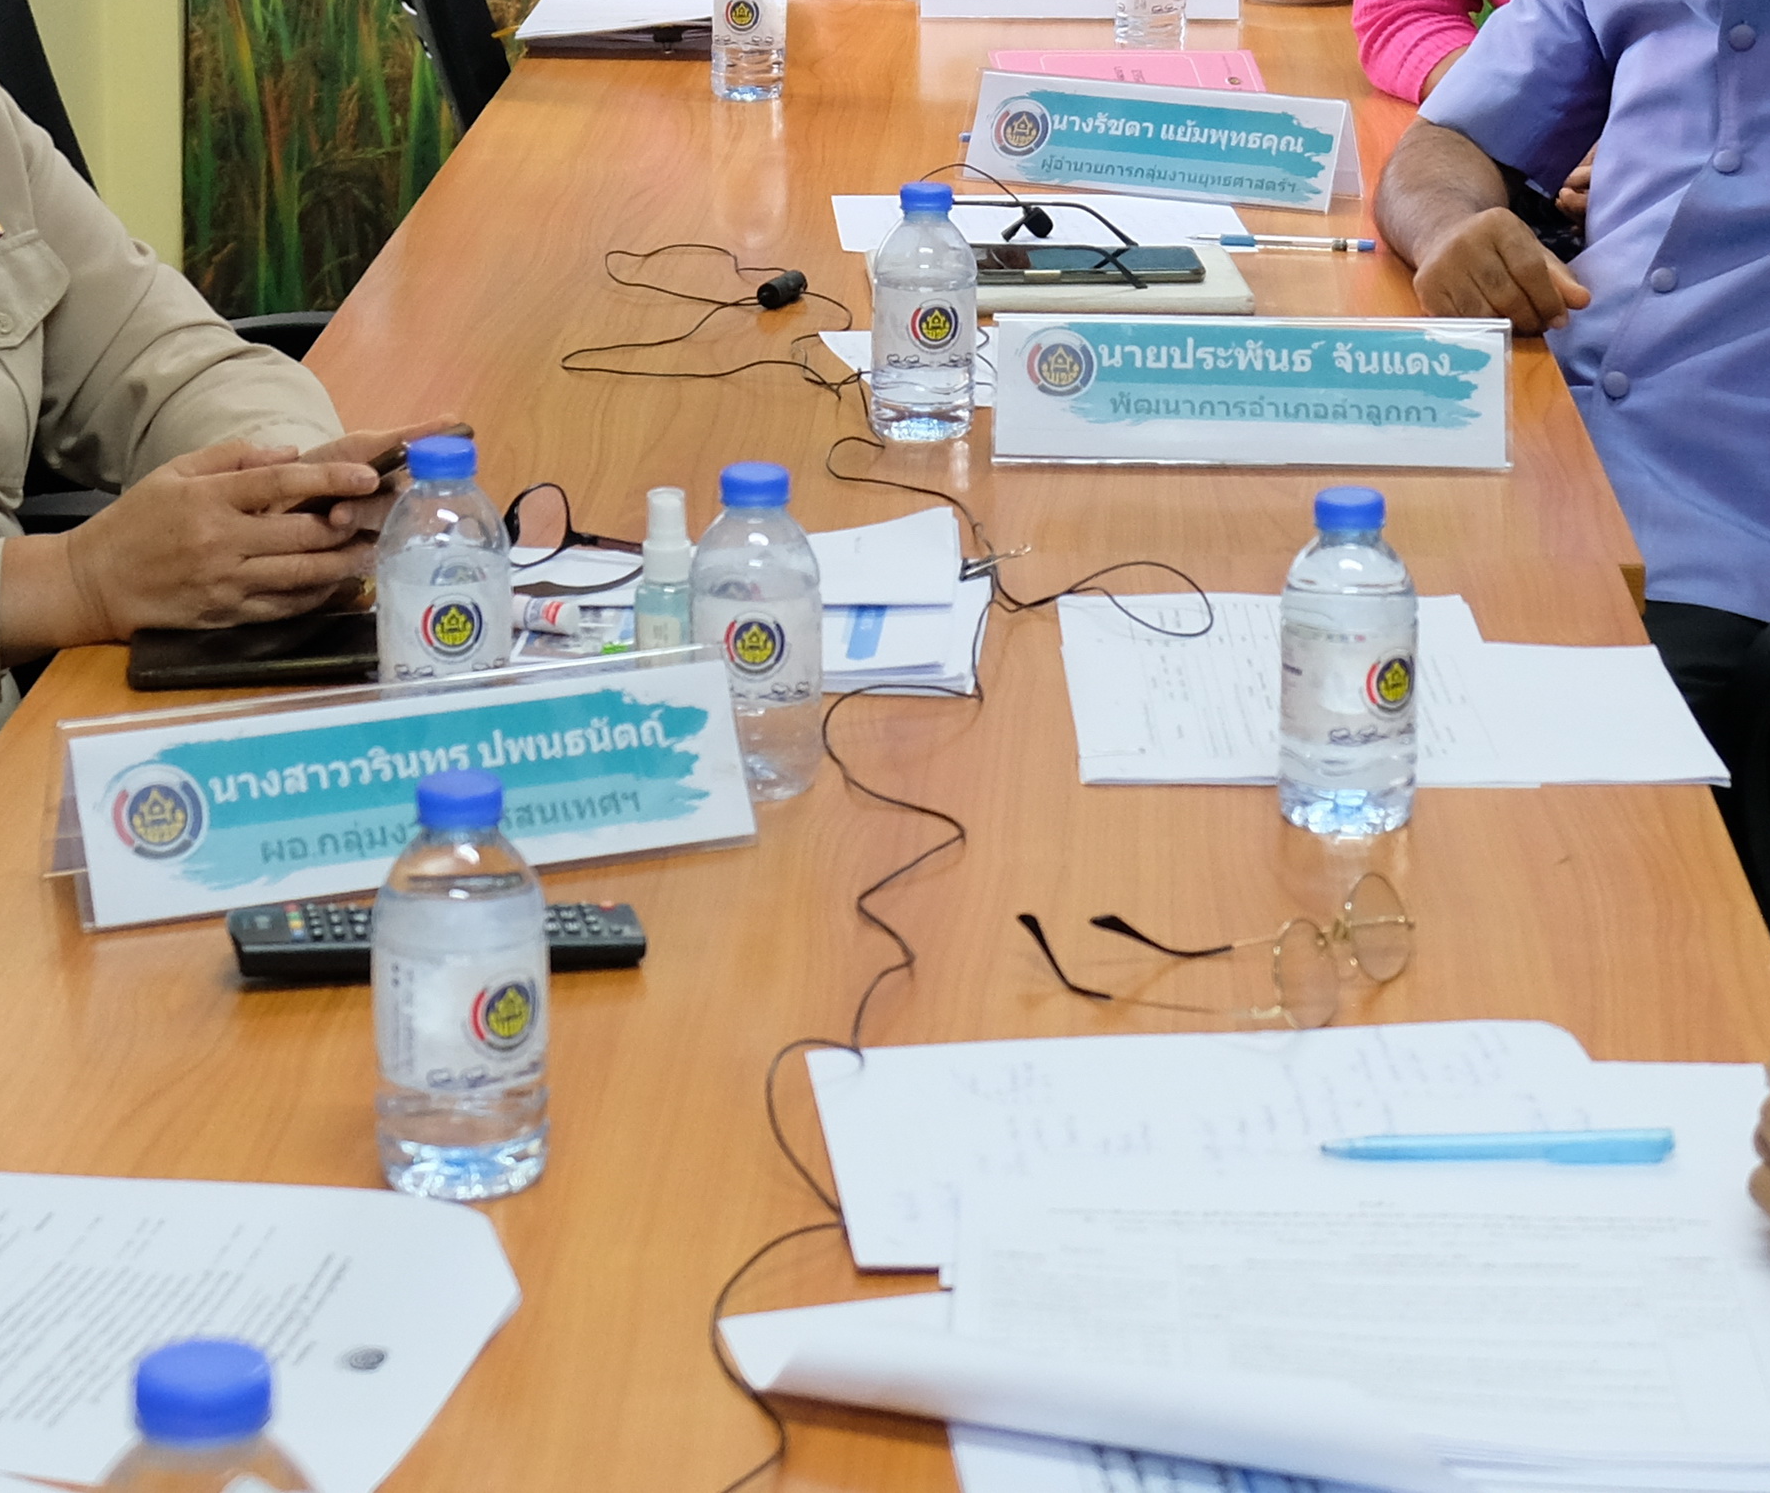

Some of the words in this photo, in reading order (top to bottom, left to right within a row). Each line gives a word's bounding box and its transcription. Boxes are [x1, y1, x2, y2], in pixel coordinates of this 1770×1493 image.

[1051, 110, 1154, 140] นางรัชดา
[1160, 118, 1306, 159] แย้มพุทธคุณ
[1040, 153, 1298, 195] ผู้อำนวยการกลุ่มงานยุทธศาสตร์ฯ
[1333, 340, 1452, 378] จันแดง
[1109, 390, 1438, 428] พัฒนาการอำเภอลำลูกกา
[208, 741, 468, 805] นางสาววรินทร
